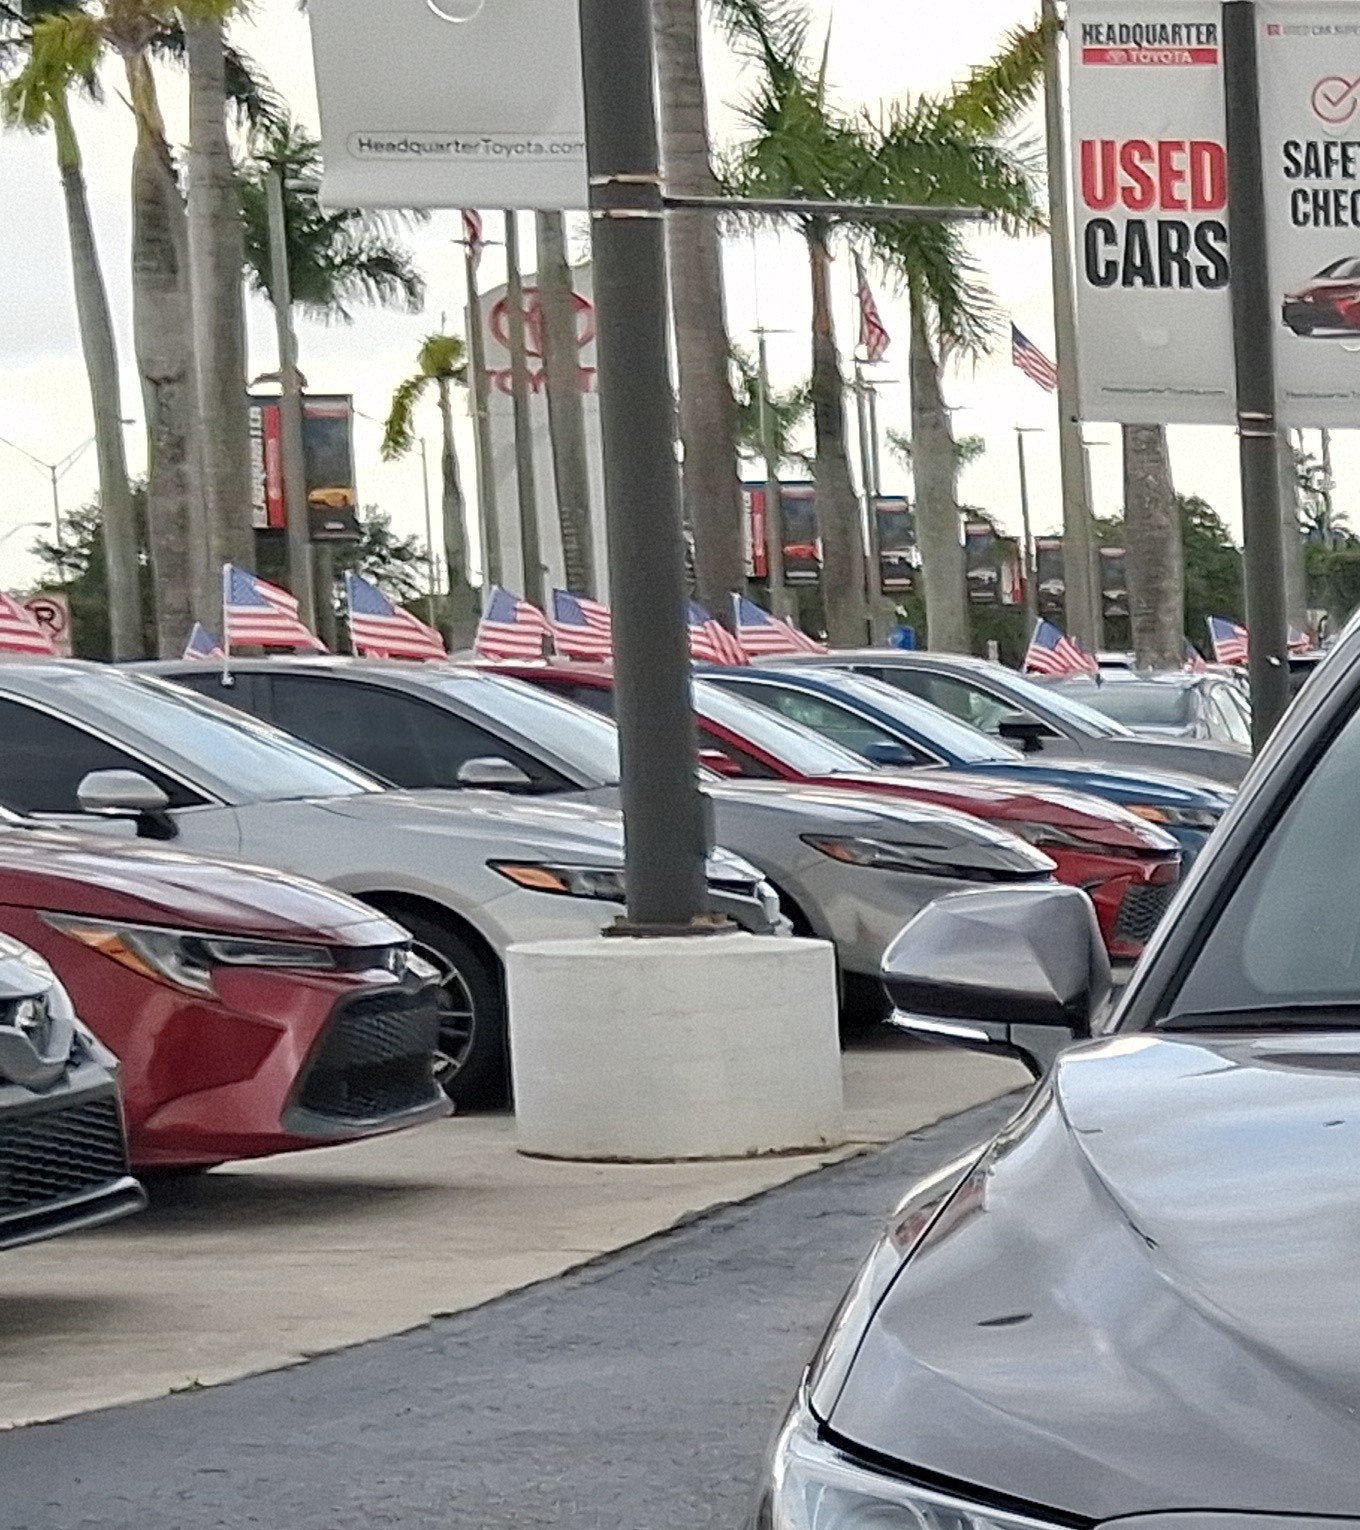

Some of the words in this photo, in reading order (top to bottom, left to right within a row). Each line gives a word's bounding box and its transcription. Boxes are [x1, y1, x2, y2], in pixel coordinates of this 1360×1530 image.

[1081, 22, 1218, 48] HEADQUARTER
[1131, 50, 1193, 64] TOYOTA
[1080, 139, 1227, 212] USED
[1084, 217, 1229, 289] CARS
